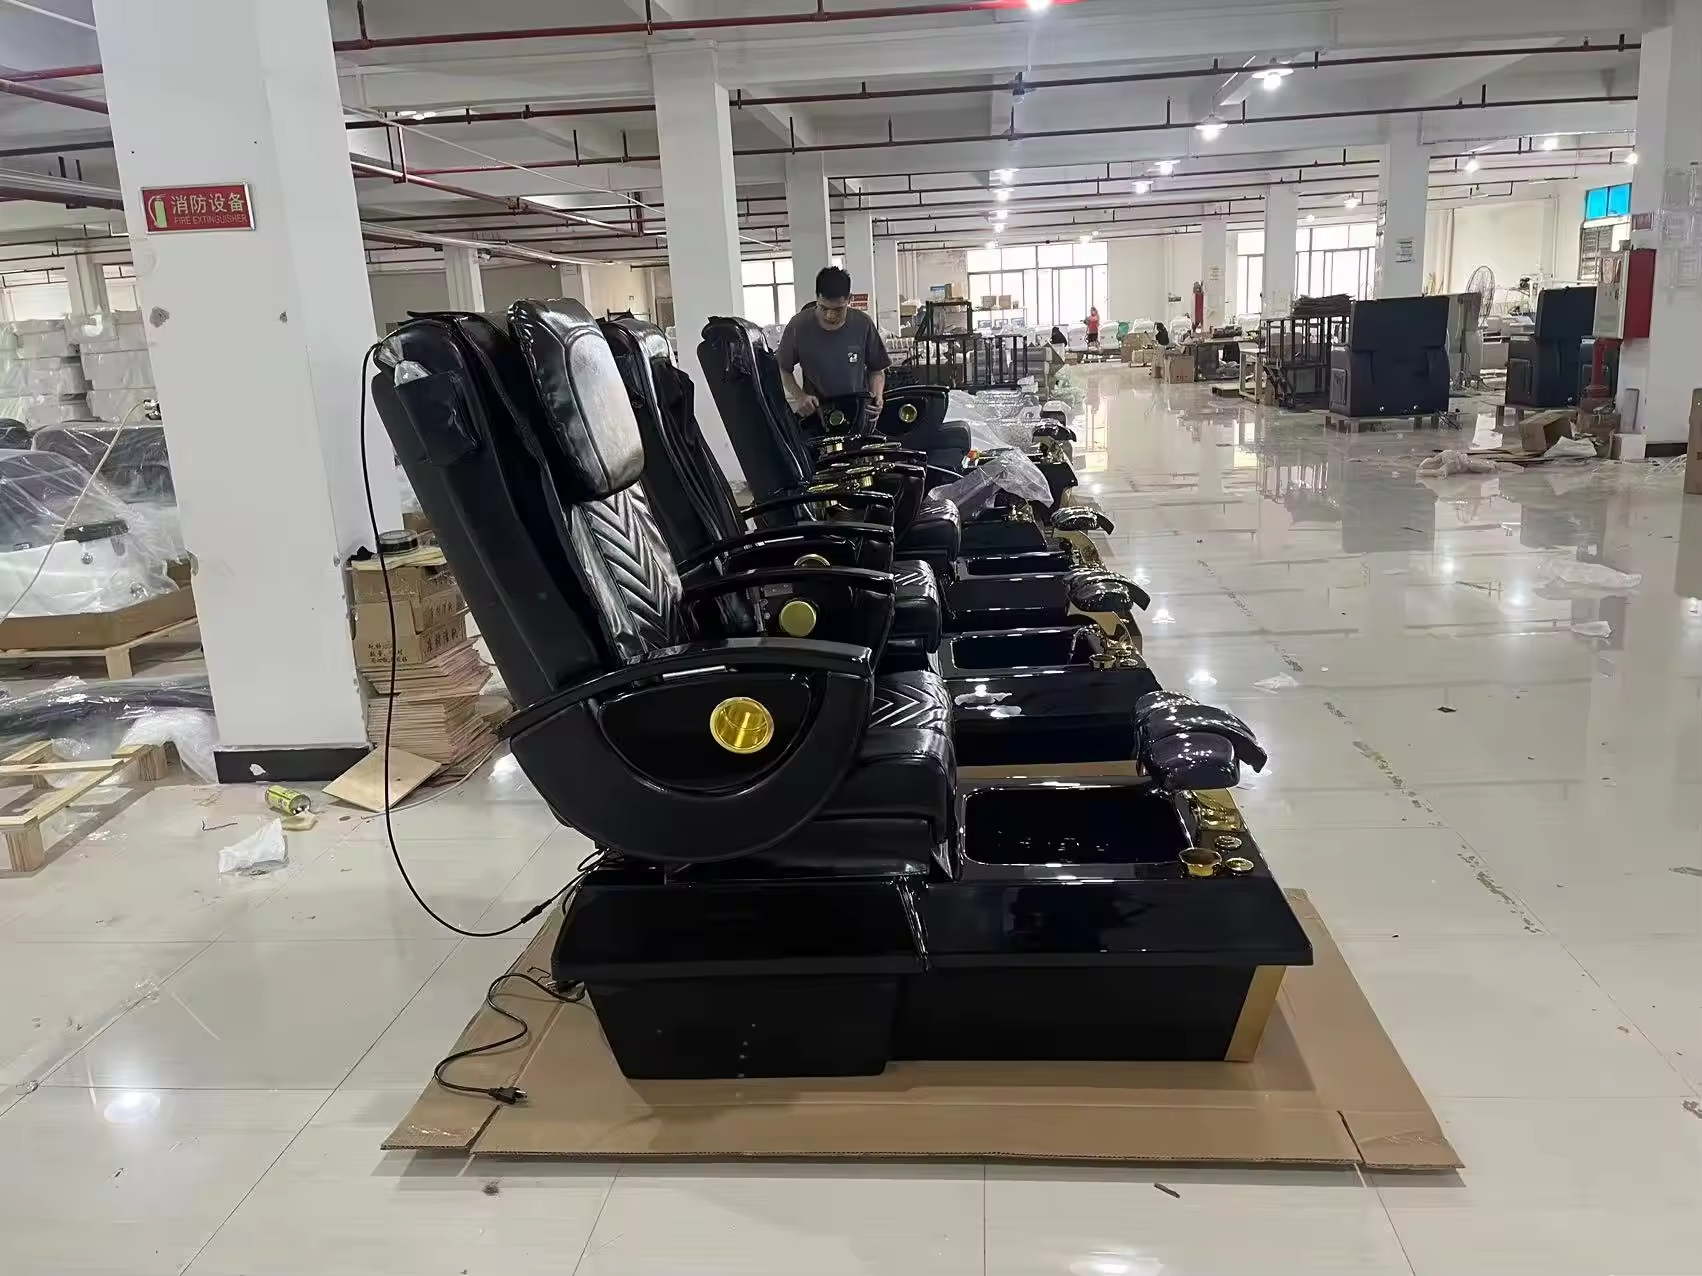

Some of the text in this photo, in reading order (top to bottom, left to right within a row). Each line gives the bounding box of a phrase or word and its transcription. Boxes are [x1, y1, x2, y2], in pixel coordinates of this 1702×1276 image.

[170, 192, 245, 215] 消防设备
[174, 213, 248, 225] FIRE EXTINGUISHER
